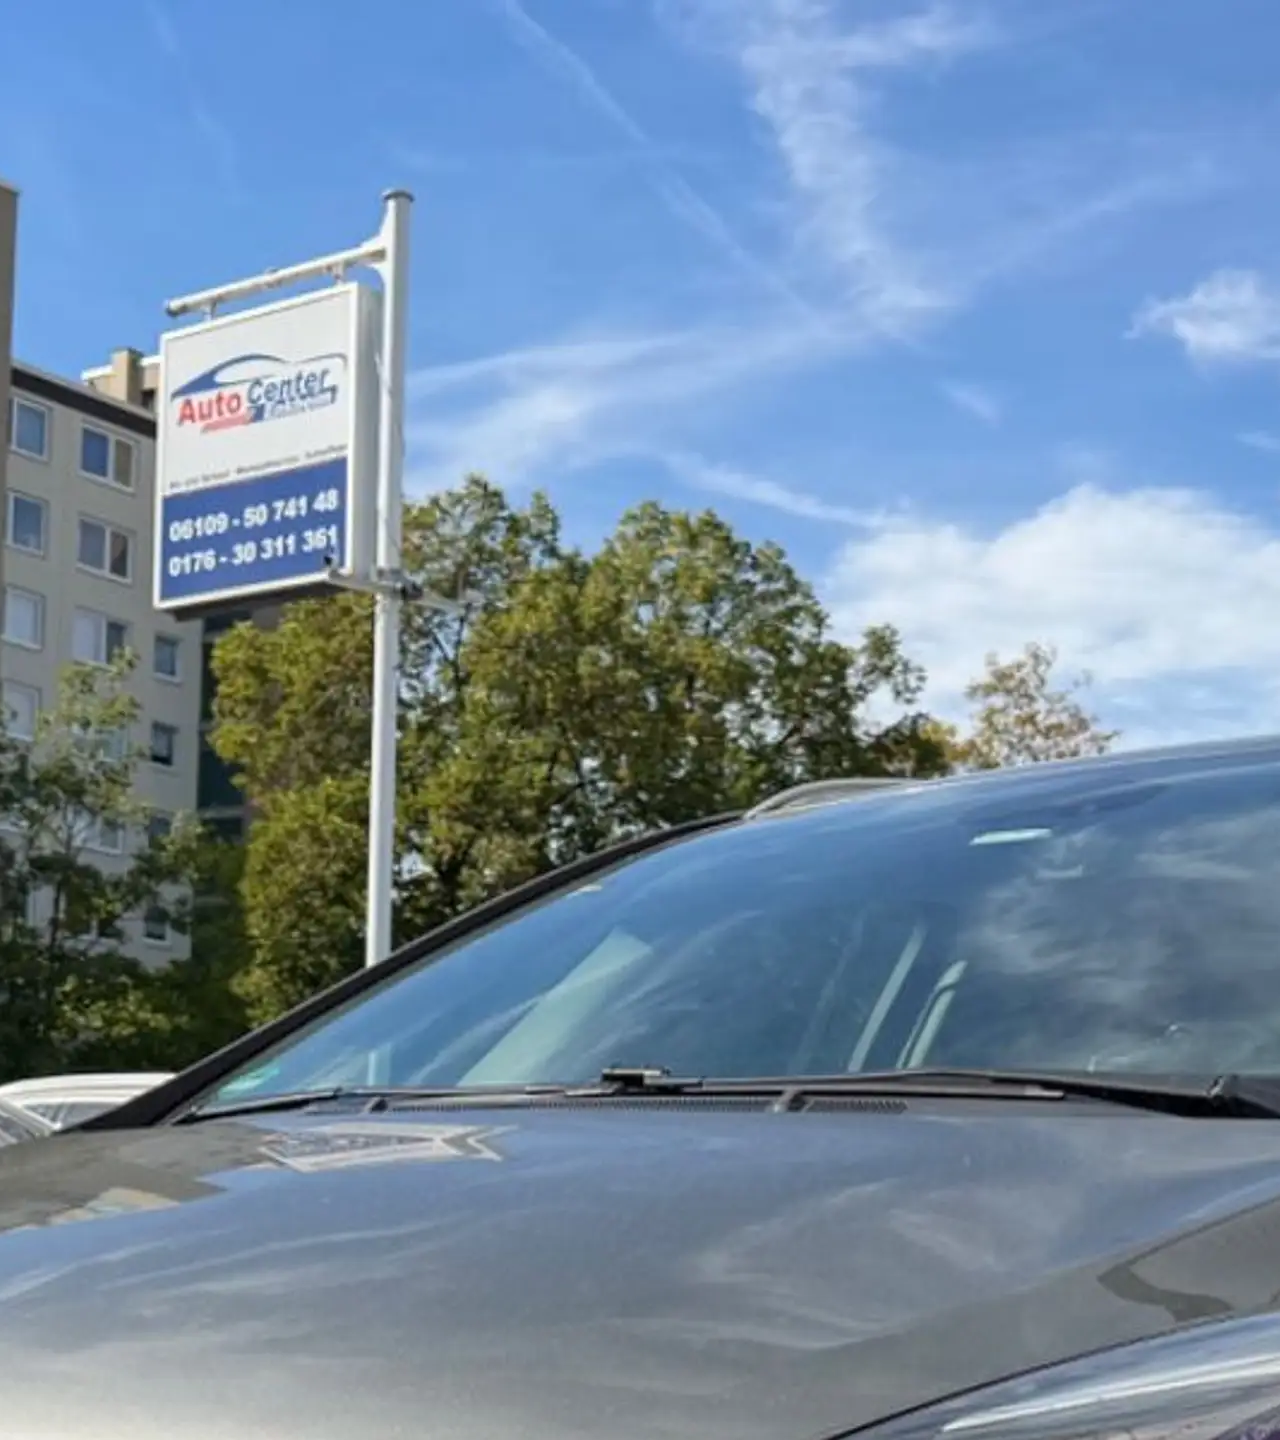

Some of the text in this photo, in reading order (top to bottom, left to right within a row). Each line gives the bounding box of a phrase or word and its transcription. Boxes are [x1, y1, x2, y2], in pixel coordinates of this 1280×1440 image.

[176, 391, 242, 426] Auto
[246, 367, 331, 406] Center
[169, 511, 229, 542] 06109
[243, 503, 269, 529] 50
[272, 495, 308, 522] 741
[312, 487, 340, 512] 48
[168, 548, 217, 577] 0176
[231, 540, 258, 566] 30
[260, 533, 297, 560] 311
[301, 524, 338, 553] 361
